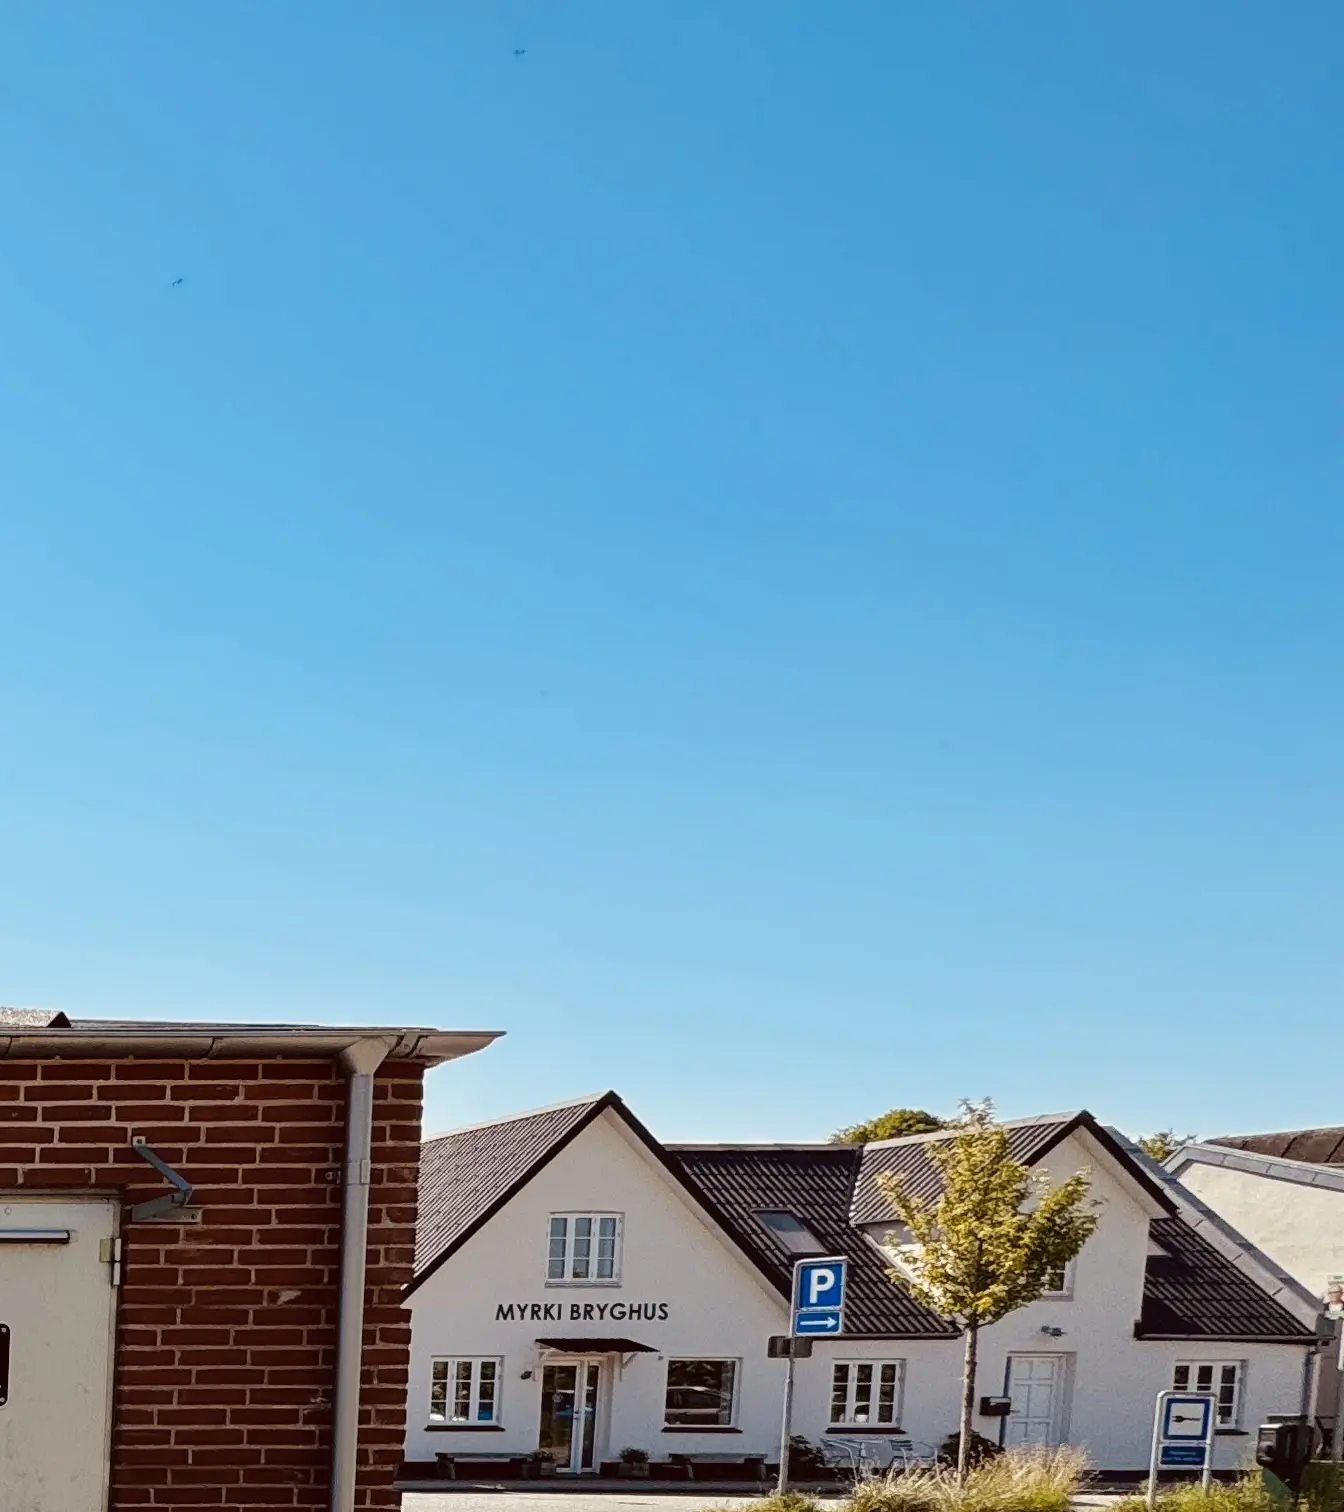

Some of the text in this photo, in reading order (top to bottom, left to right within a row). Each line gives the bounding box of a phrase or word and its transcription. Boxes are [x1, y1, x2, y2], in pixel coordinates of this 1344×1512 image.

[809, 1268, 835, 1304] P
[495, 1302, 669, 1321] MYRKI BRYGHUS
